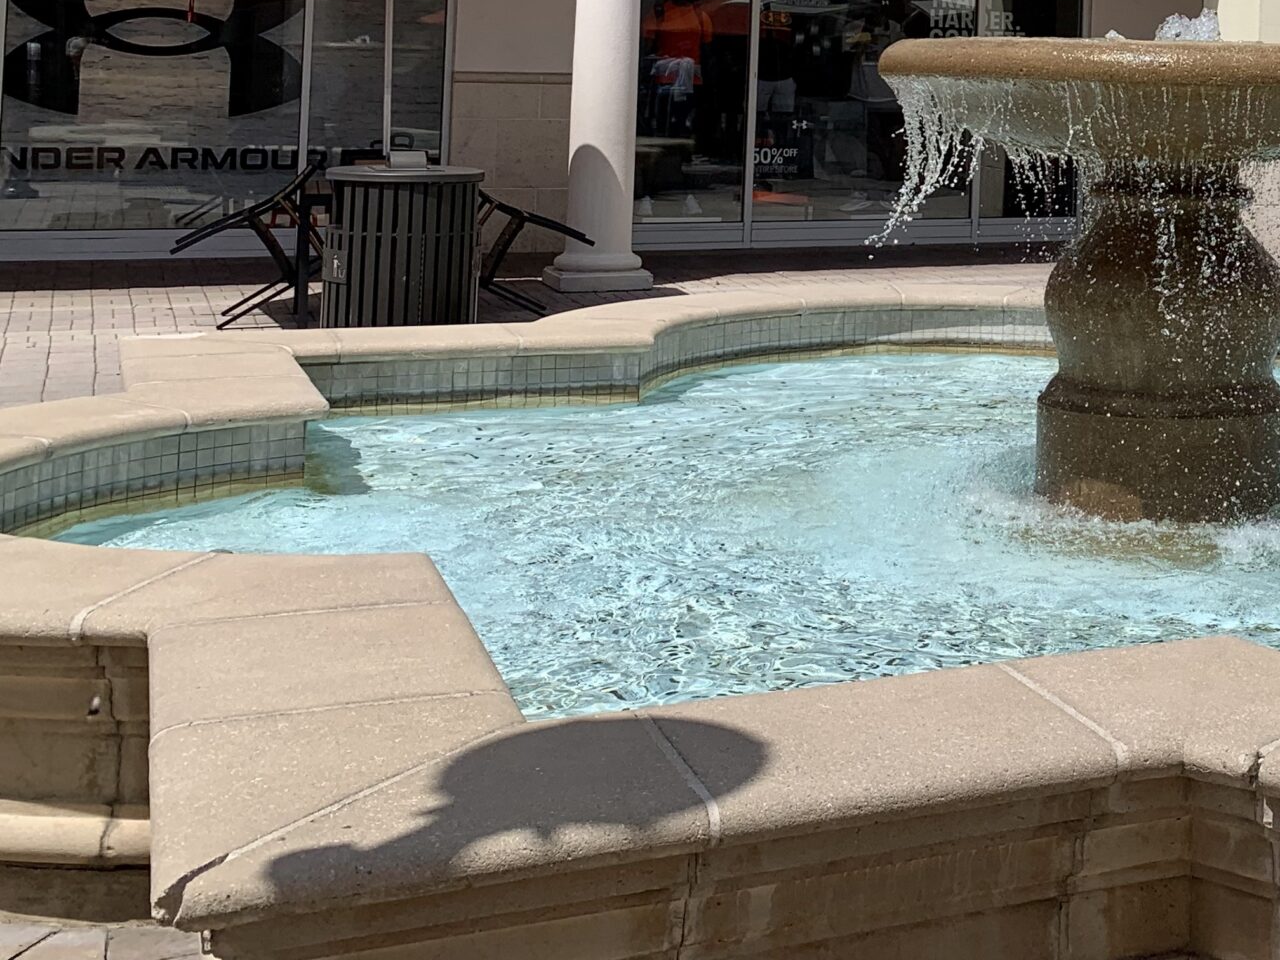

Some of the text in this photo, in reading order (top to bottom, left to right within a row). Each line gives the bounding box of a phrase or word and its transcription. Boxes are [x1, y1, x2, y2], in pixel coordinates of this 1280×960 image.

[134, 146, 328, 171] ARMOUR
[753, 148, 799, 164] 50% OFF
